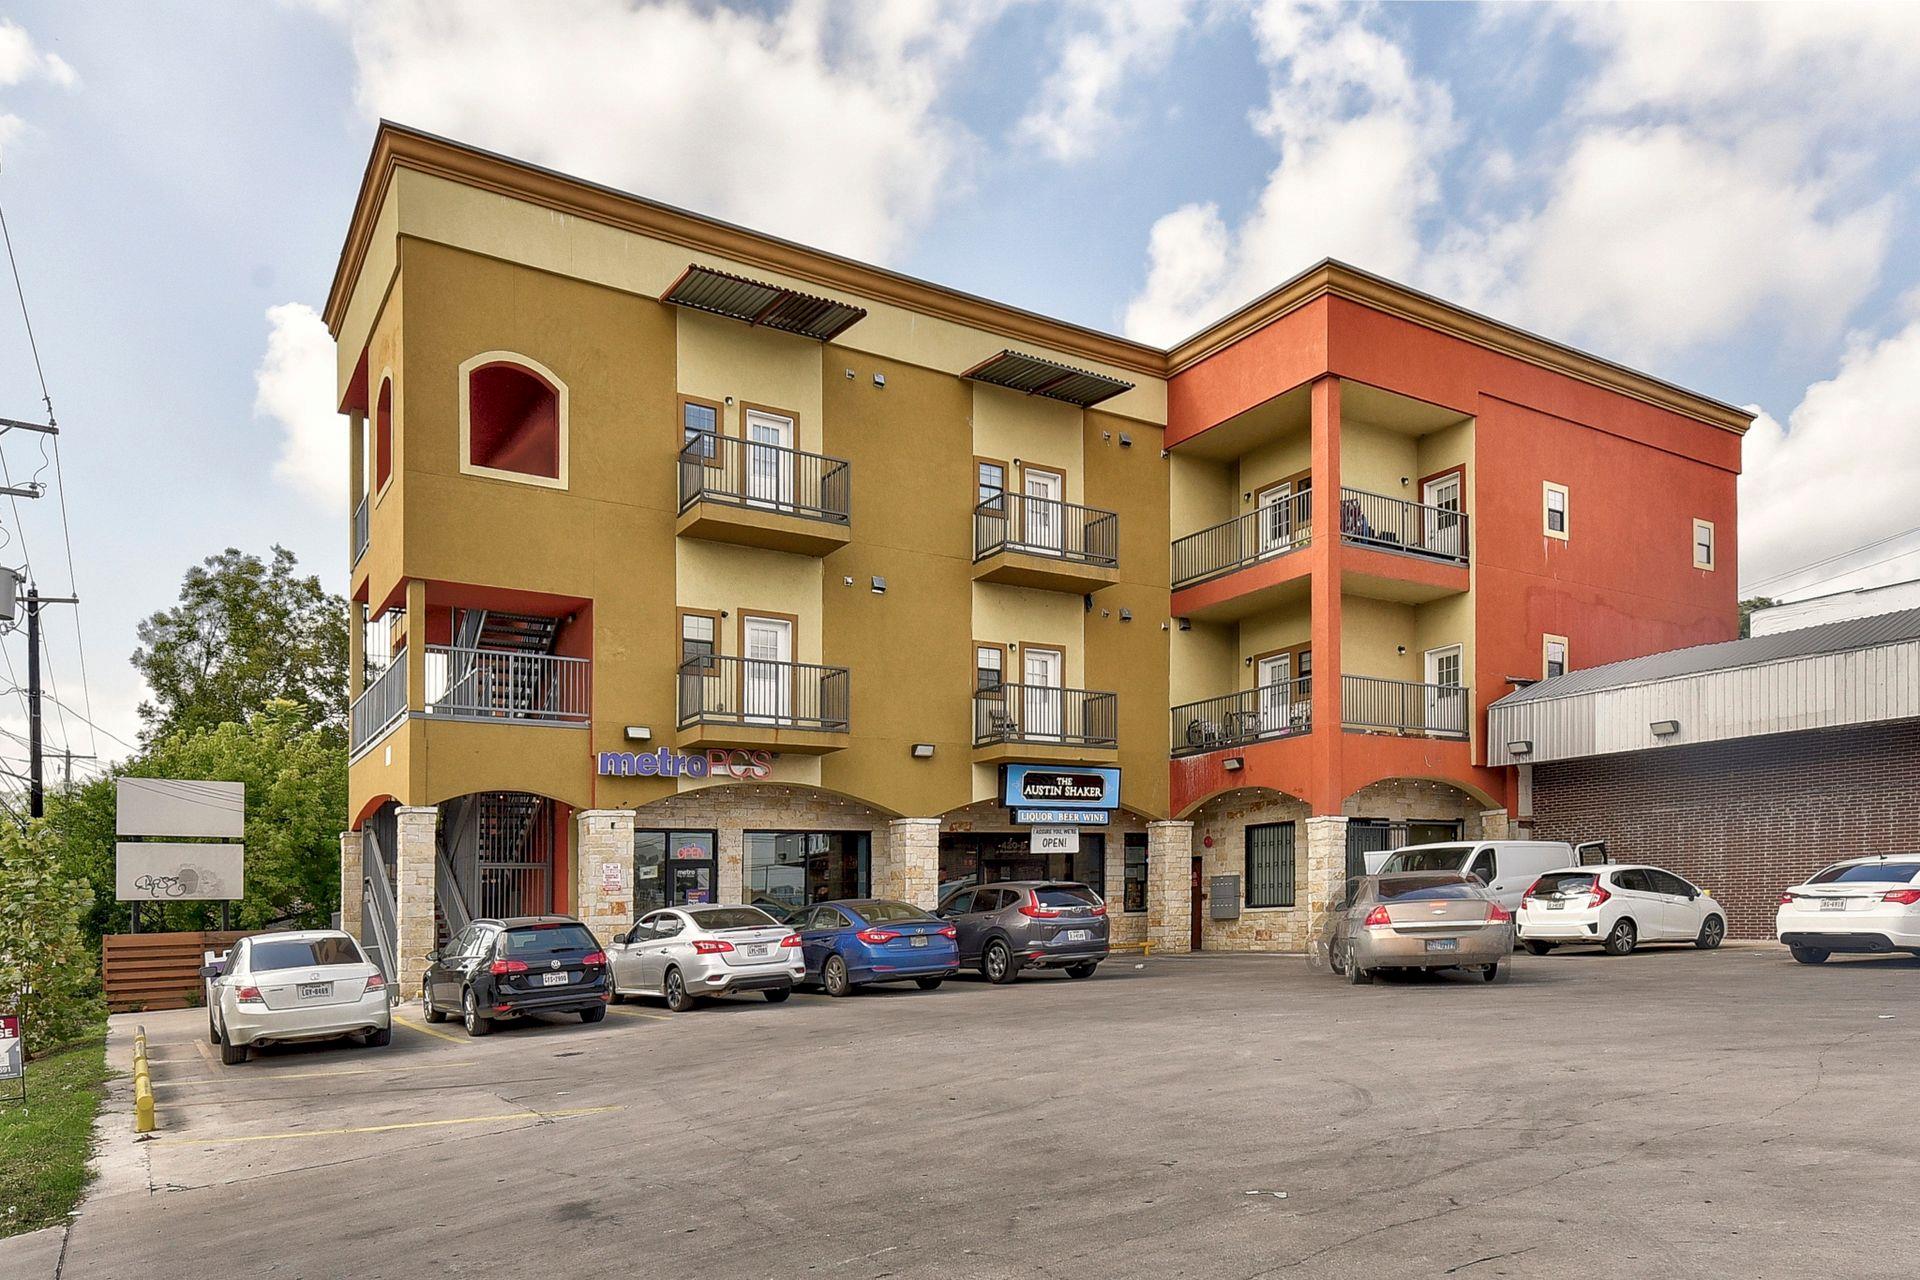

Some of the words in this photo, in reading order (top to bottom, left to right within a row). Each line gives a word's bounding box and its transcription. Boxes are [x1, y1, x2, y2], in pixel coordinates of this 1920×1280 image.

[598, 747, 773, 780] metroPCS
[1056, 777, 1073, 786] THE
[1024, 785, 1062, 796] AUSTIN
[1065, 786, 1102, 797] SHAKER
[1021, 812, 1053, 822] LIQUOR
[1058, 813, 1079, 821] BEER
[1083, 813, 1104, 822] WINE
[1042, 837, 1067, 848] OPEN!
